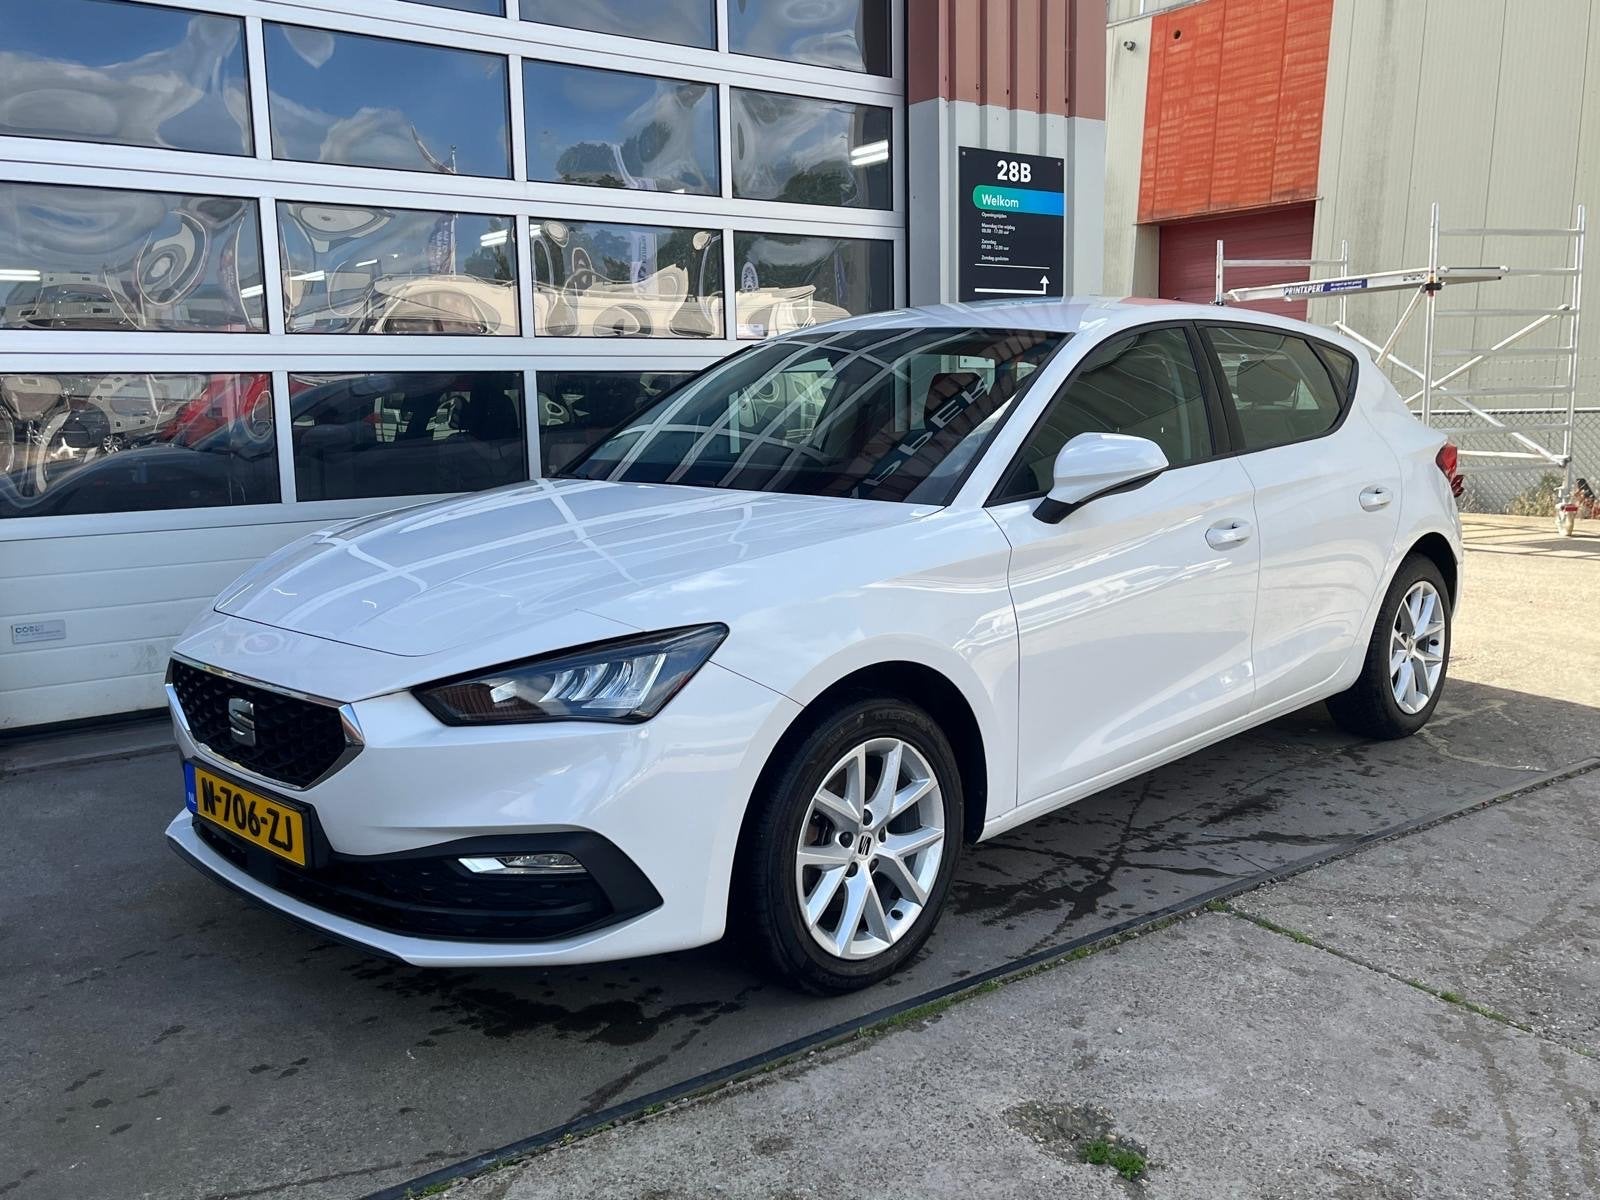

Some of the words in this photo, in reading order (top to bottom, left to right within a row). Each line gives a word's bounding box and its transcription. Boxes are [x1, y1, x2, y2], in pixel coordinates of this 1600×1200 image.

[997, 160, 1032, 183] 28B
[981, 193, 1019, 209] Welkom
[1284, 284, 1325, 295] PRINTXPERT
[188, 791, 197, 804] NL
[201, 776, 293, 852] N-706-ZJ
